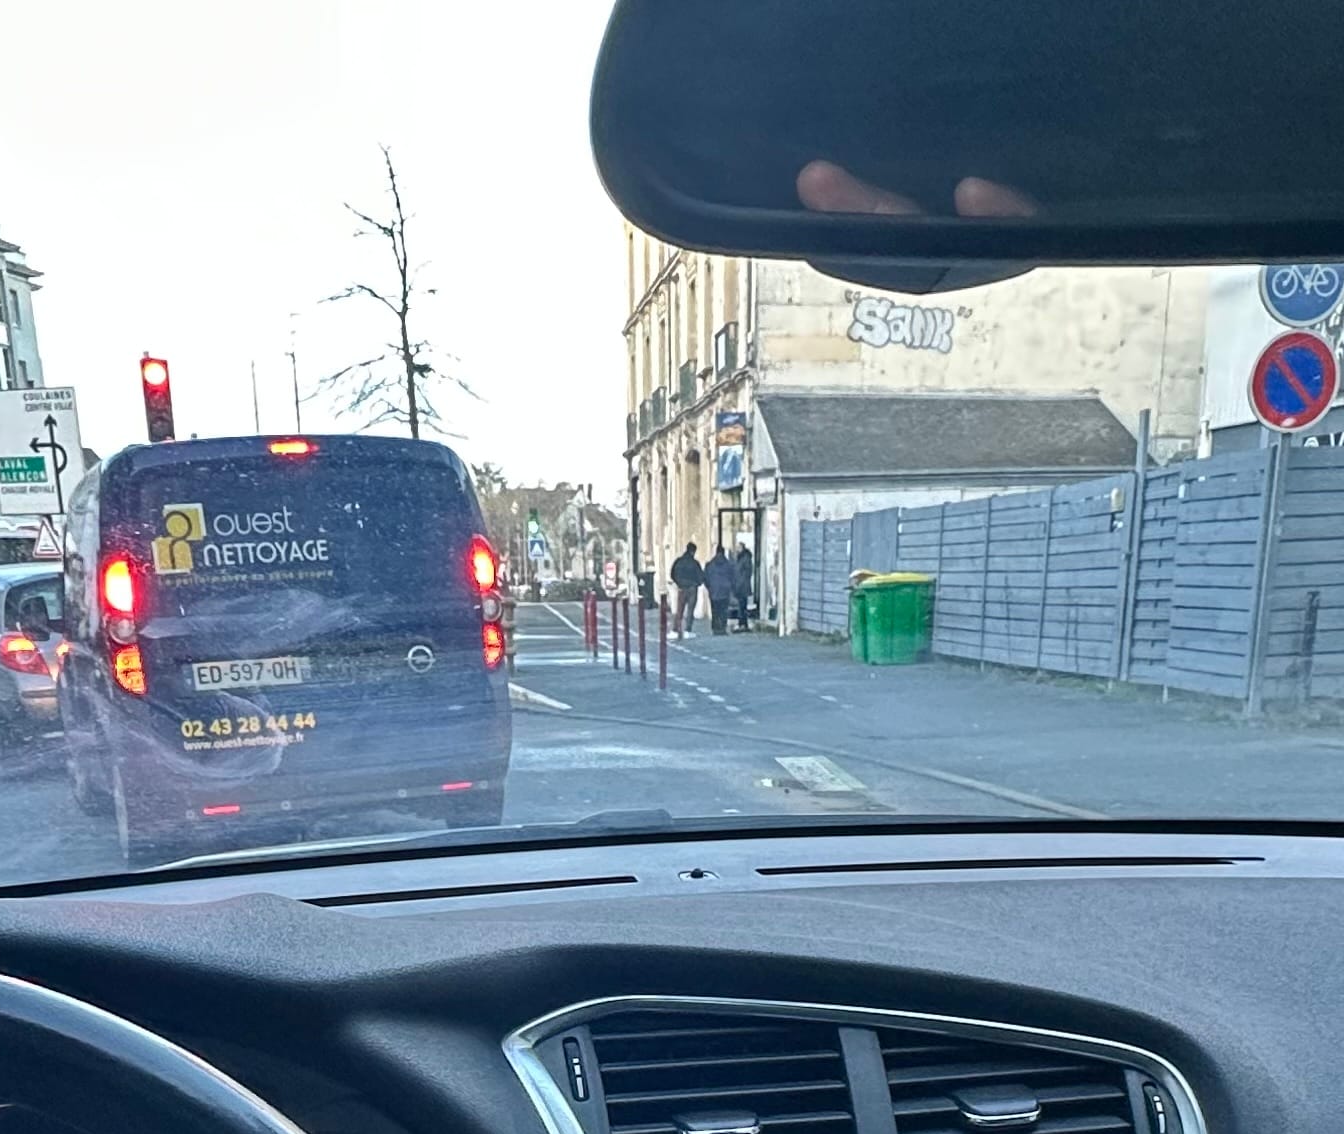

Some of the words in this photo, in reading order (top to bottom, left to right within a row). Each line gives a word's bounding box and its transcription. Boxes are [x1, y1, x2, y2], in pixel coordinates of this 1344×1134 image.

[23, 390, 72, 402] COULAINES
[25, 403, 53, 412] CENTRE
[56, 401, 73, 411] VILLE
[181, 719, 205, 738] 02
[210, 717, 232, 736] 43
[238, 716, 261, 733] 28
[266, 713, 289, 731] 44
[293, 711, 316, 729] 44
